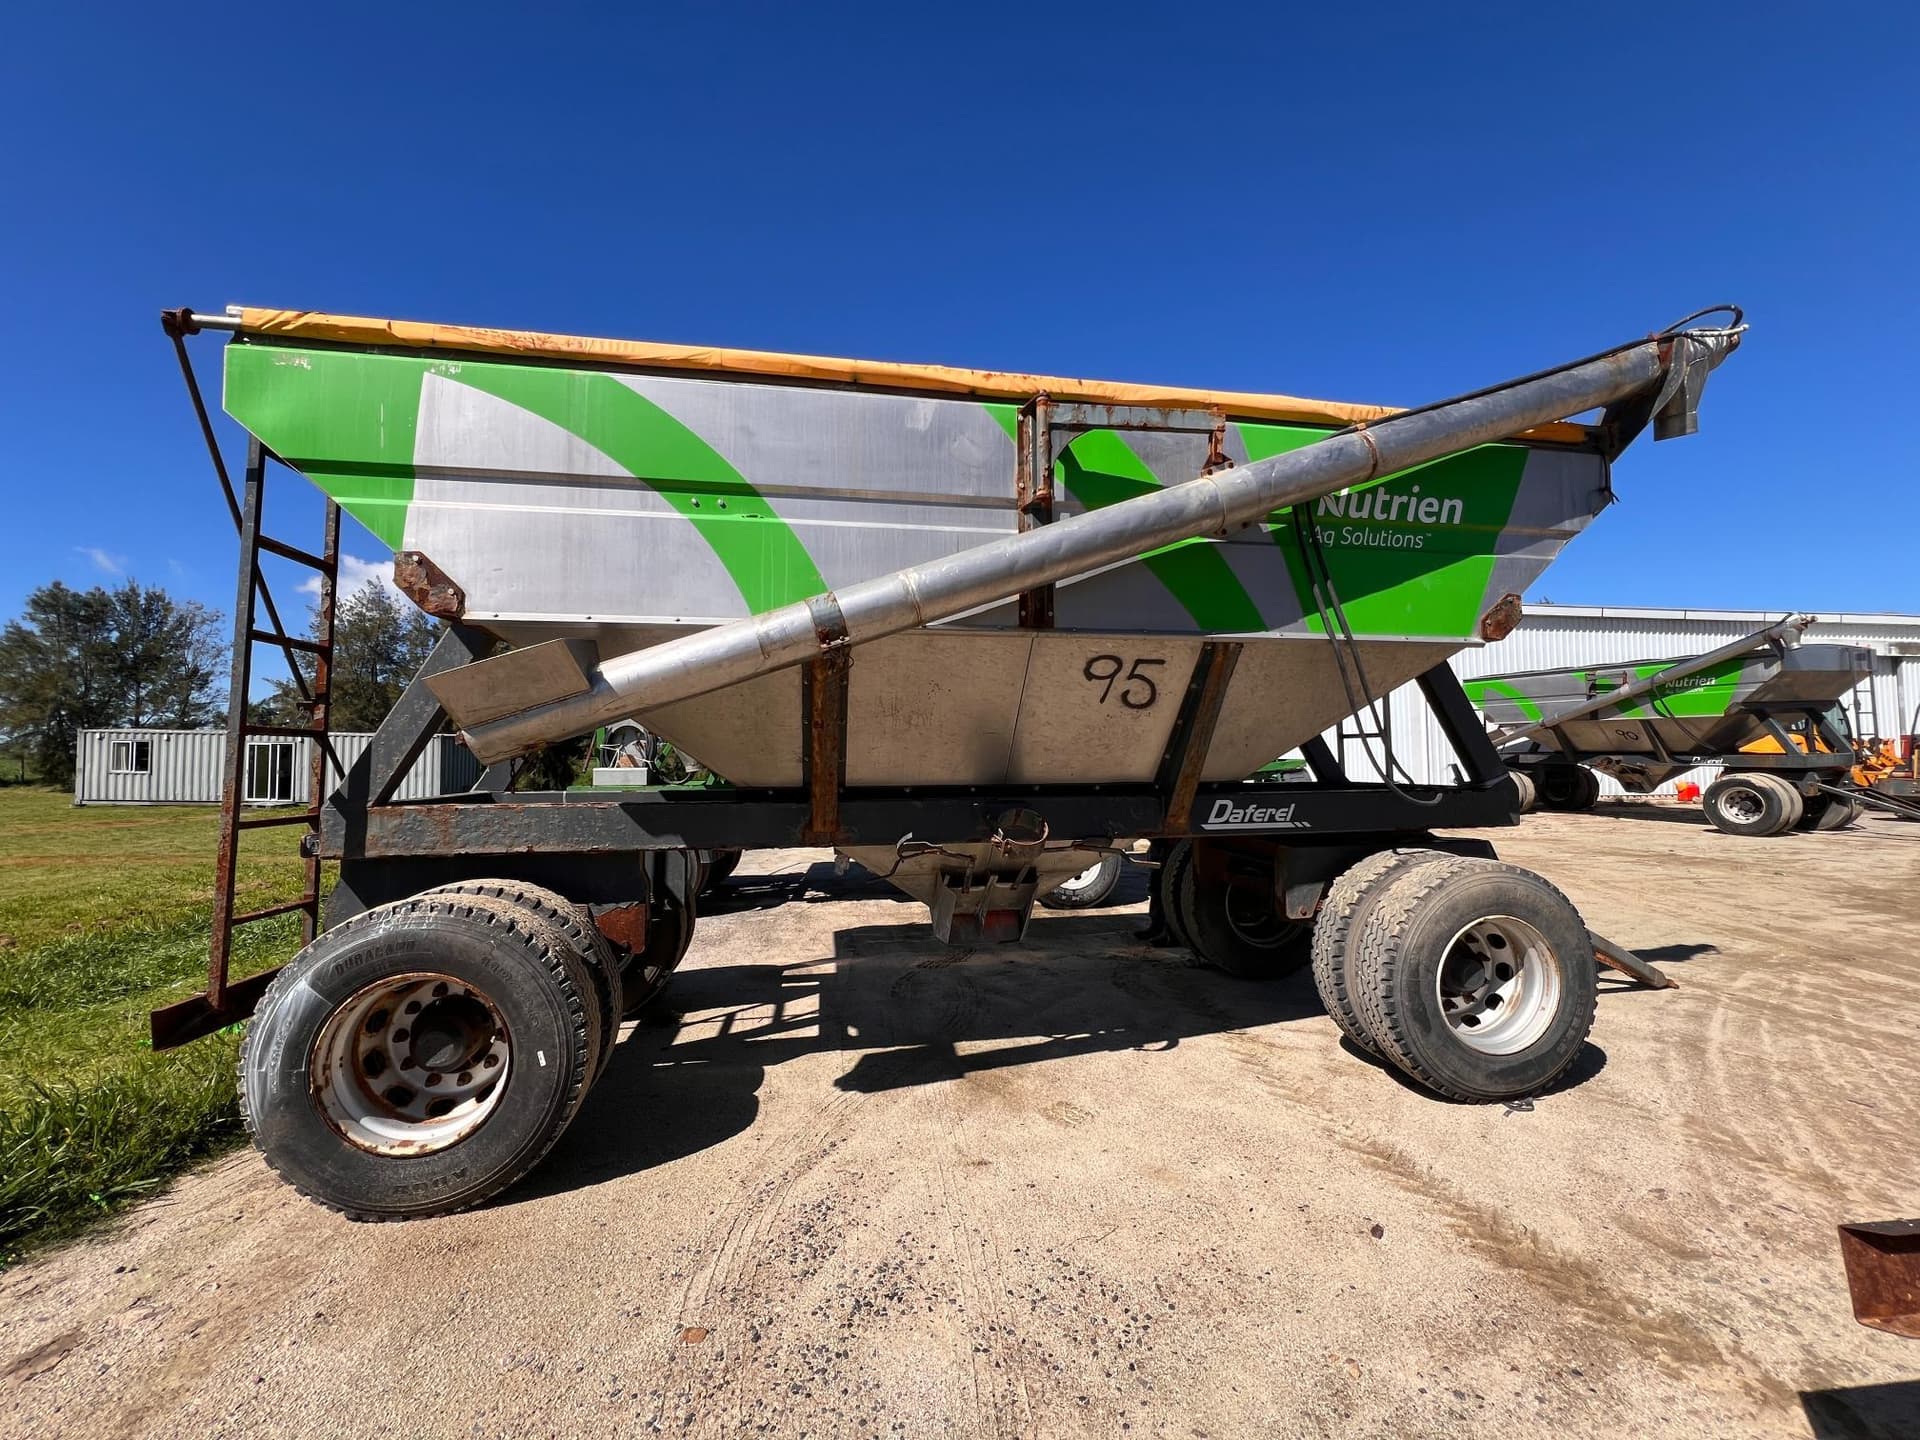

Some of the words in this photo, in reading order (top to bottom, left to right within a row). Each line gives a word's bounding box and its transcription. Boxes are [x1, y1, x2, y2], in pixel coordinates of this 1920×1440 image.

[1317, 485, 1463, 524] Nutrien
[1309, 525, 1335, 547] Ag
[1083, 655, 1166, 709] 95
[1665, 675, 1716, 688] Nutrien
[1207, 799, 1296, 824] Daferel
